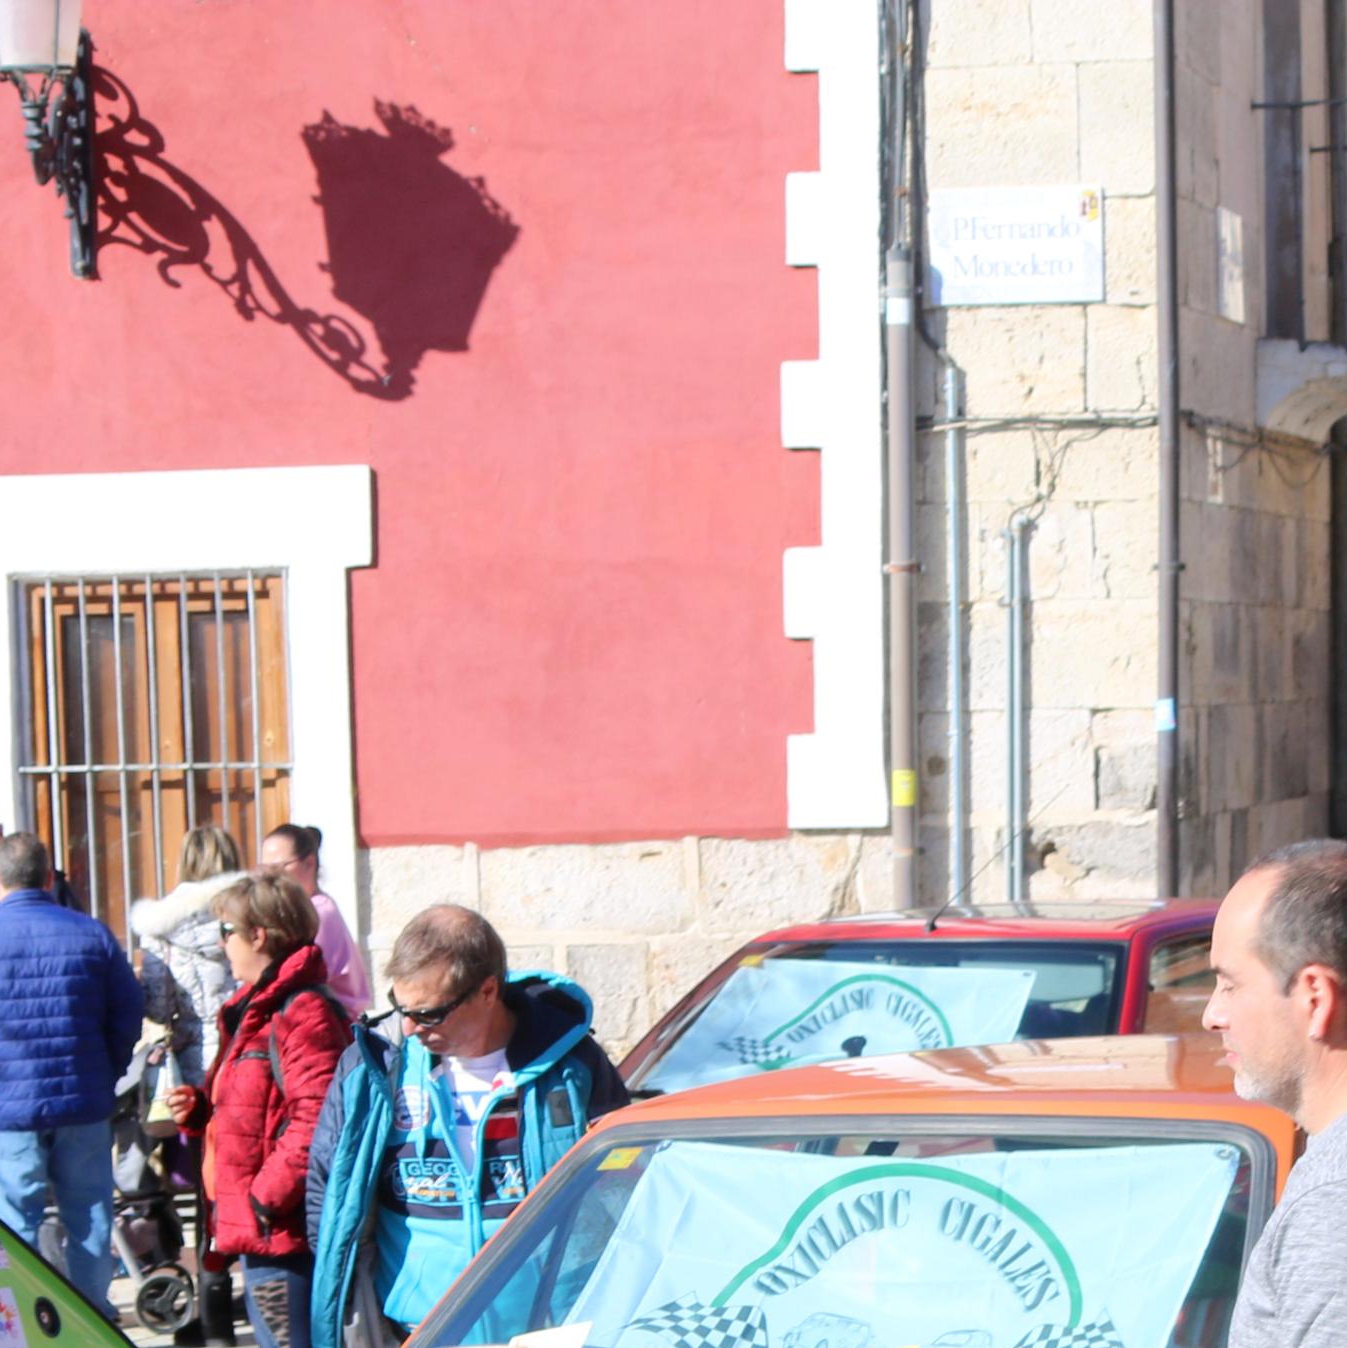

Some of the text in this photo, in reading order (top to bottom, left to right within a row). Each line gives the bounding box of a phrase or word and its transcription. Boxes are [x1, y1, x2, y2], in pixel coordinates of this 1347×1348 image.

[954, 253, 1074, 279] Monedero
[753, 1188, 1060, 1312] OXICLASIC CIGALES
